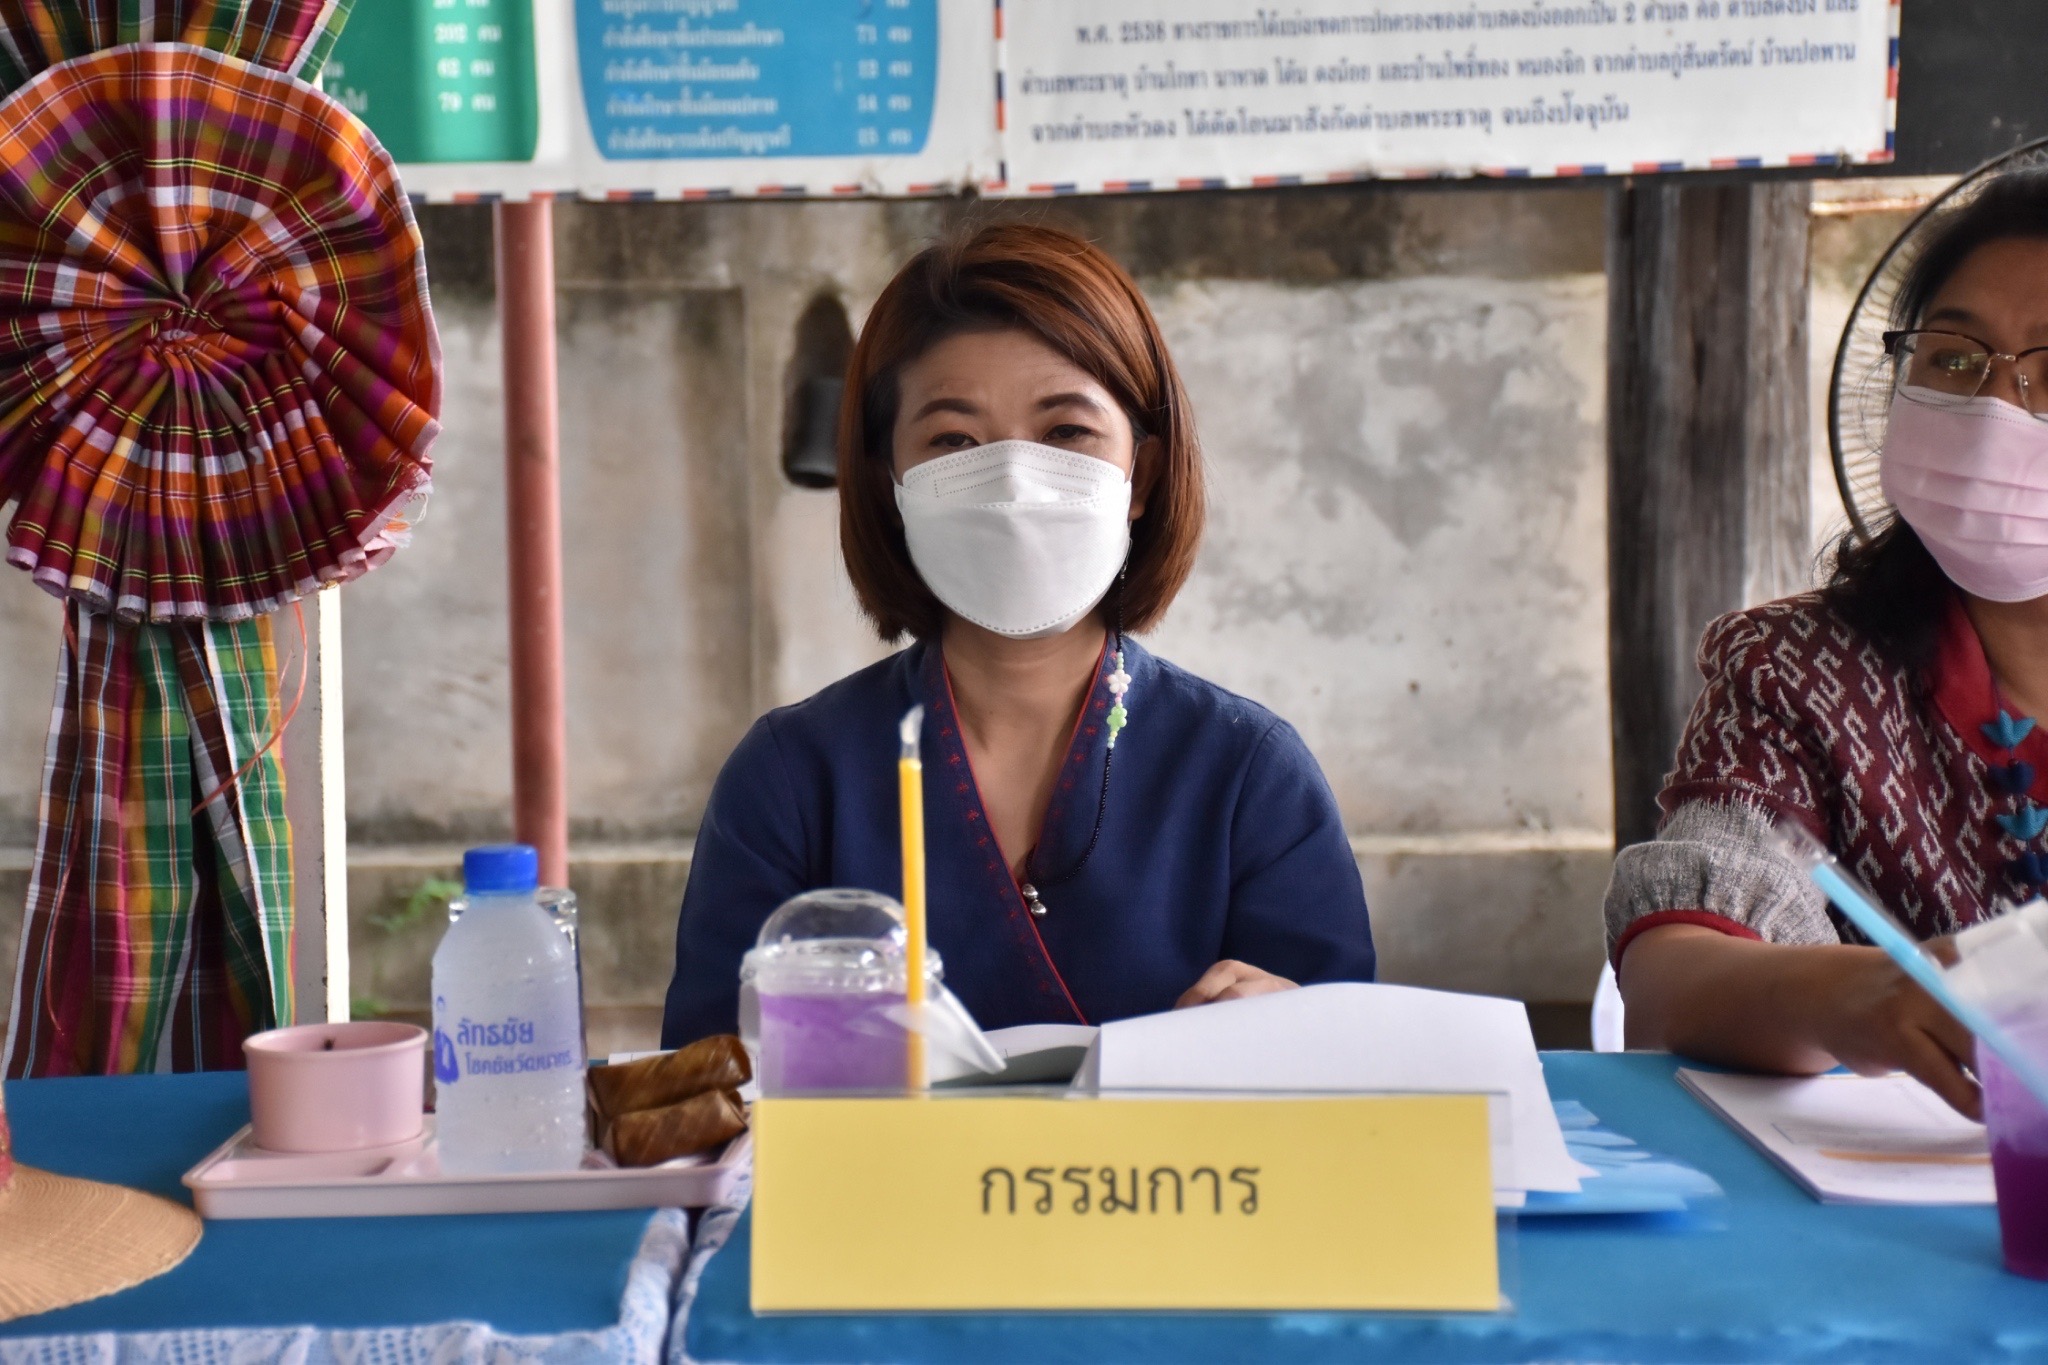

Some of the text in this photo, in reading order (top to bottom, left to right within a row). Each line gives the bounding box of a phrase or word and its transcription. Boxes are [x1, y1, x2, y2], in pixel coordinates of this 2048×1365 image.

[1625, 2, 1636, 22] 2
[1502, 89, 1629, 131] จนถึงปัจจุบัน
[980, 1165, 1261, 1216] กรรมการ
